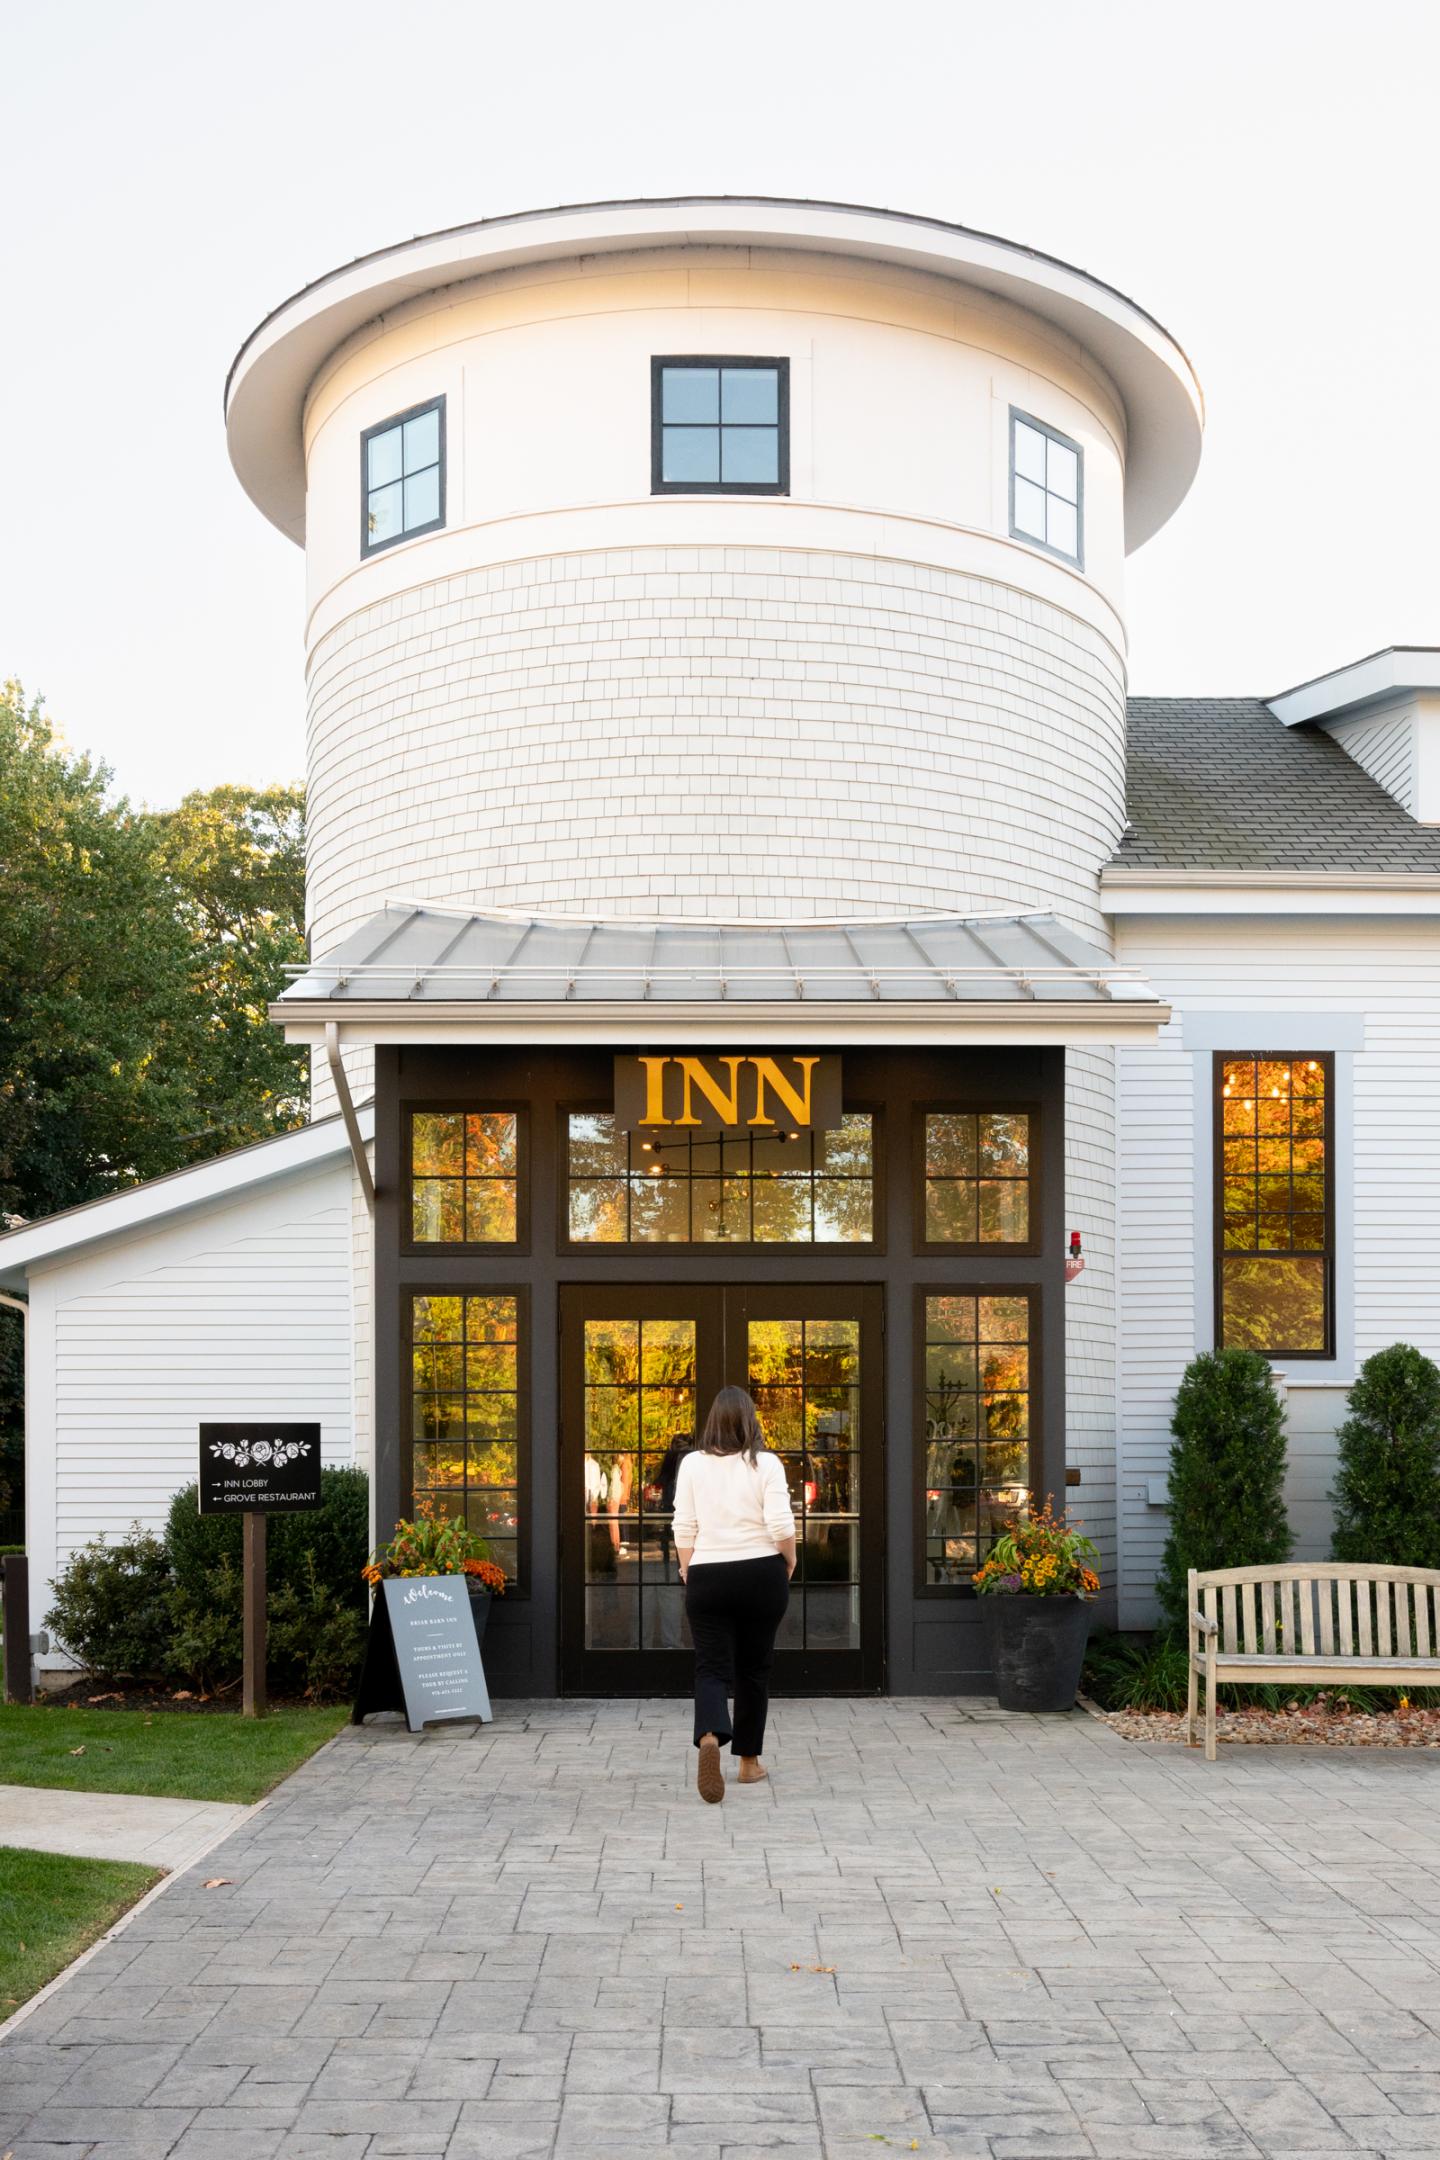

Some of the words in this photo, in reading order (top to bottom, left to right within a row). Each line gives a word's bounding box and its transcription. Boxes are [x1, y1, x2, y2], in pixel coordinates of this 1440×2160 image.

[638, 1056, 820, 1125] INN
[1066, 1260, 1083, 1269] FIRE
[224, 1480, 240, 1488] INN
[242, 1479, 269, 1488] LOBBY
[223, 1494, 257, 1503] GROVE
[258, 1492, 317, 1501] RESTAURANT
[403, 1584, 454, 1605] Welcome
[429, 1617, 445, 1625] BARN
[413, 1652, 451, 1661] APPOINTMENT
[439, 1669, 463, 1677] REQUEST
[445, 1678, 468, 1686] CALLING
